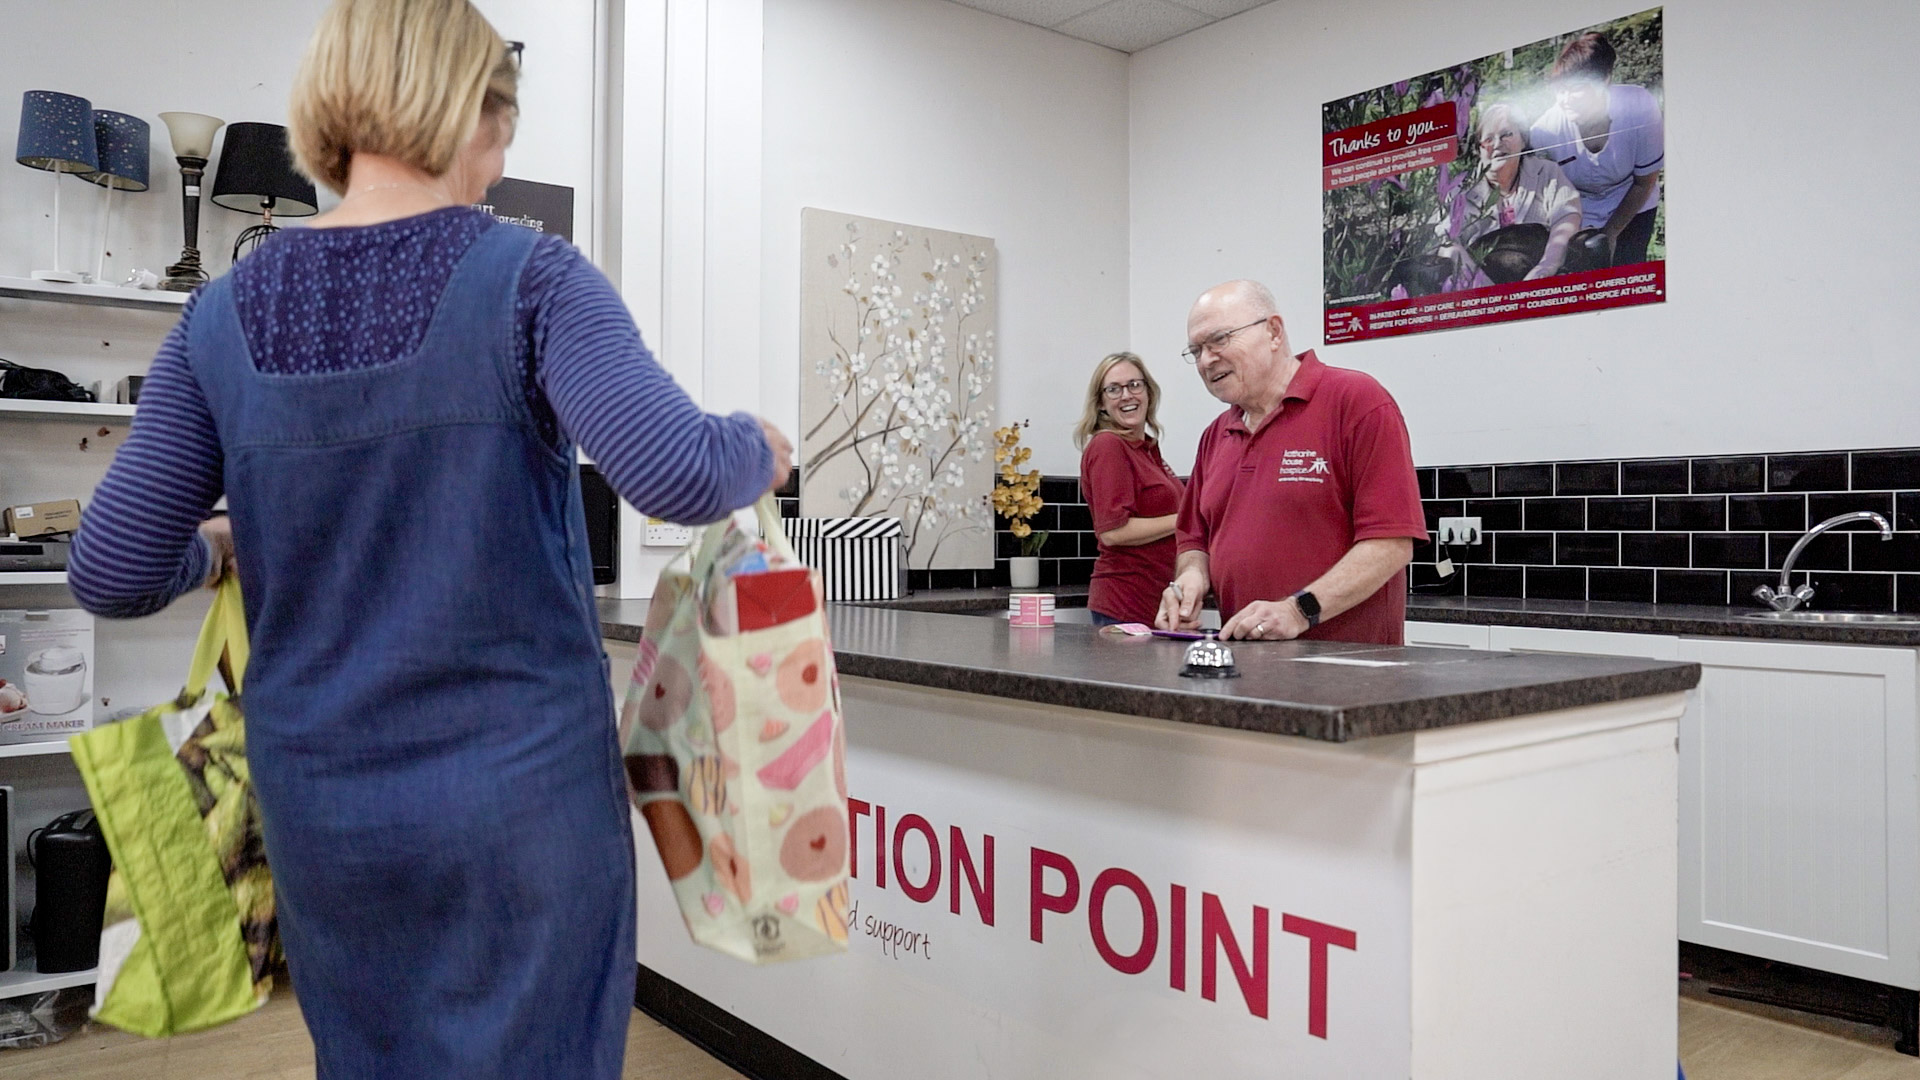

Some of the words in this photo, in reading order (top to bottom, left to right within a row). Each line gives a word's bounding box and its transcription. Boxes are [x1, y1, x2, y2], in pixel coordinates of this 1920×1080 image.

[1328, 131, 1380, 157] Thanks
[1387, 129, 1401, 142] to
[1405, 121, 1448, 144] you...
[1331, 168, 1342, 176] We
[1342, 165, 1354, 173] can
[1355, 158, 1383, 170] continue
[1392, 149, 1417, 163] provide
[1418, 146, 1432, 155] free
[1432, 142, 1448, 151] care
[1331, 178, 1338, 186] to
[1338, 174, 1354, 184] local
[1354, 170, 1378, 182] people
[1378, 165, 1391, 175] and
[1391, 161, 1407, 172] their
[1369, 319, 1394, 331] RESPITE
[1394, 317, 1407, 327] FOR
[1408, 314, 1434, 325] CARERS
[1439, 307, 1486, 321] BEREAVEMENT
[1486, 303, 1519, 315] SUPPORT
[1526, 295, 1578, 309] COUNSELLING
[1586, 289, 1620, 301] HOSPICE
[1620, 287, 1631, 296] AT
[1631, 283, 1657, 295] HOME
[1400, 306, 1418, 316] CARE
[1424, 304, 1437, 313] DAY
[1437, 302, 1455, 311] CARE
[1461, 298, 1480, 308] DROP
[1480, 297, 1489, 305] IN
[1489, 295, 1503, 304] DAY
[1509, 286, 1562, 301] LYMPHOEDEMA
[1562, 282, 1588, 293] CLINIC
[1595, 277, 1627, 289] CARERS
[1627, 273, 1657, 284] GROUP
[1281, 457, 1304, 466] house
[46, 719, 85, 730] MAKER
[865, 914, 931, 960] support
[1030, 847, 1357, 1040] POINT
